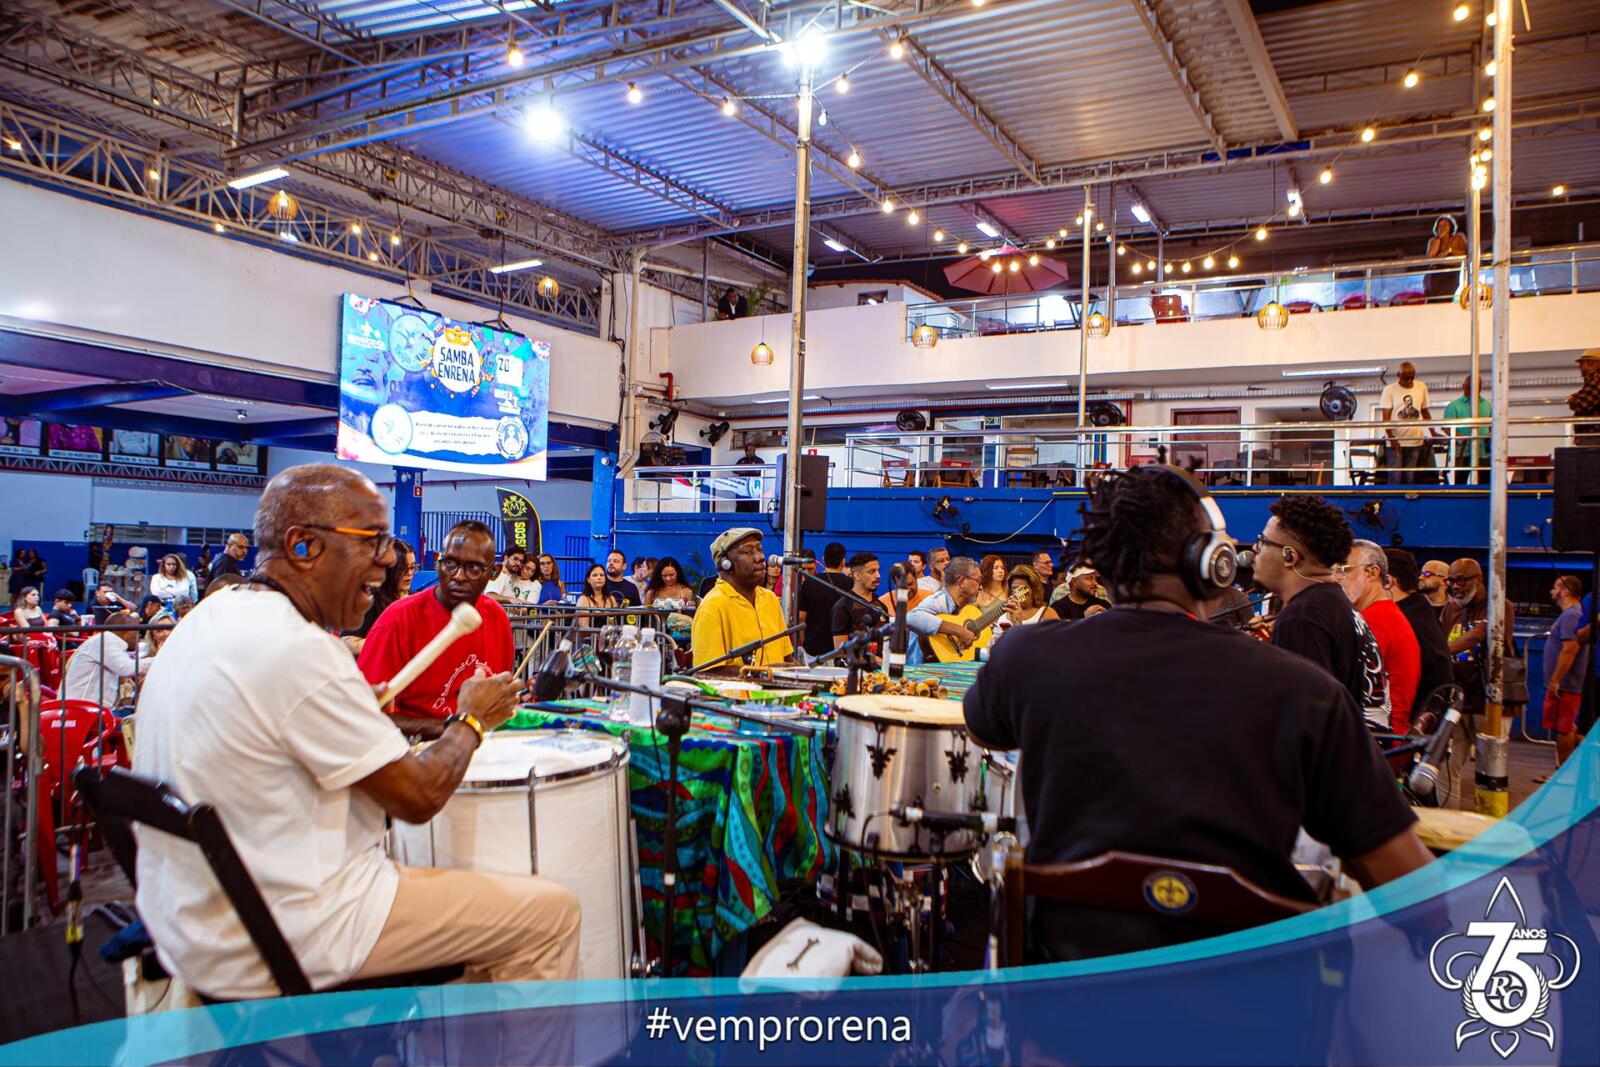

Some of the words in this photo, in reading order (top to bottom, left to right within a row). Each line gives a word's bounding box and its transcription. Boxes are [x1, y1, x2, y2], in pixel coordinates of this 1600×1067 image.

[440, 346, 474, 367] SAMBA
[497, 357, 509, 372] 20
[438, 362, 475, 384] ENRENA
